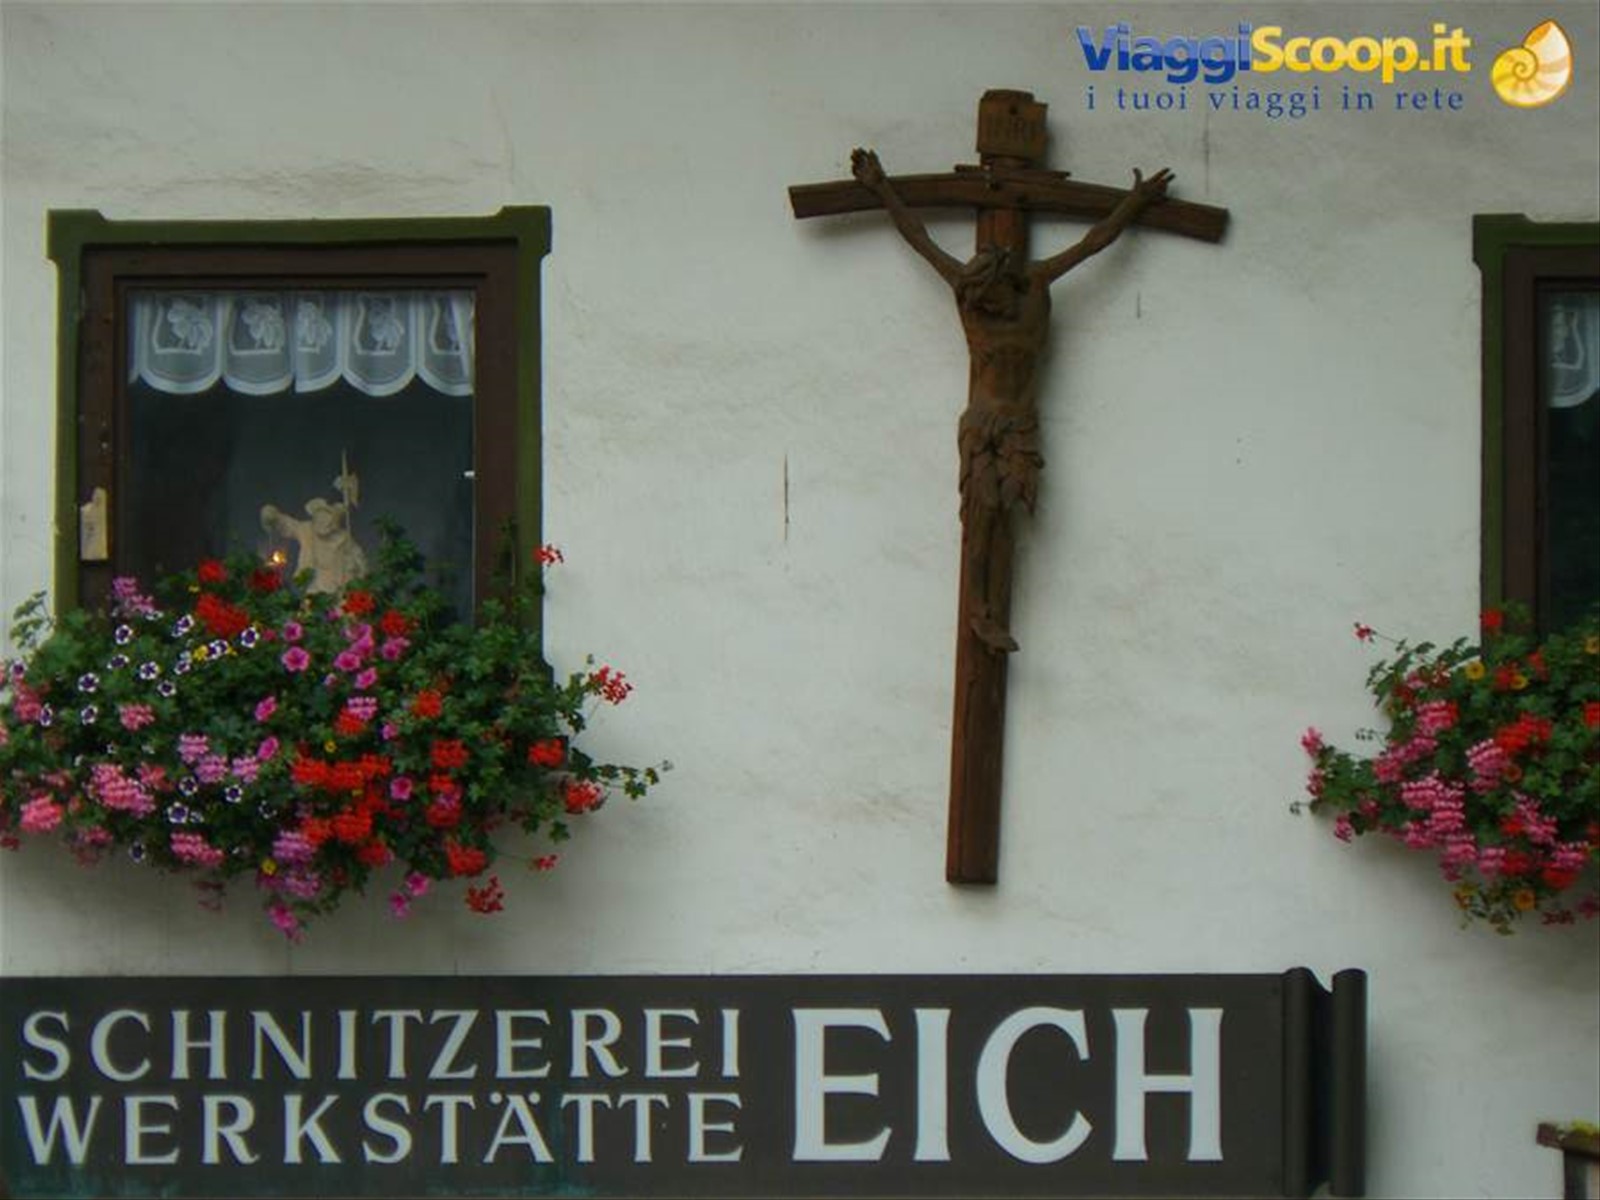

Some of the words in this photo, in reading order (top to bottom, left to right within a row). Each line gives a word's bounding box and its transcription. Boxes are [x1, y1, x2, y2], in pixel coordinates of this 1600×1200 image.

[22, 1008, 741, 1082] SCHNITZEREI
[792, 1005, 1225, 1164] EICH
[17, 1092, 743, 1165] WERKSTÄTTE
